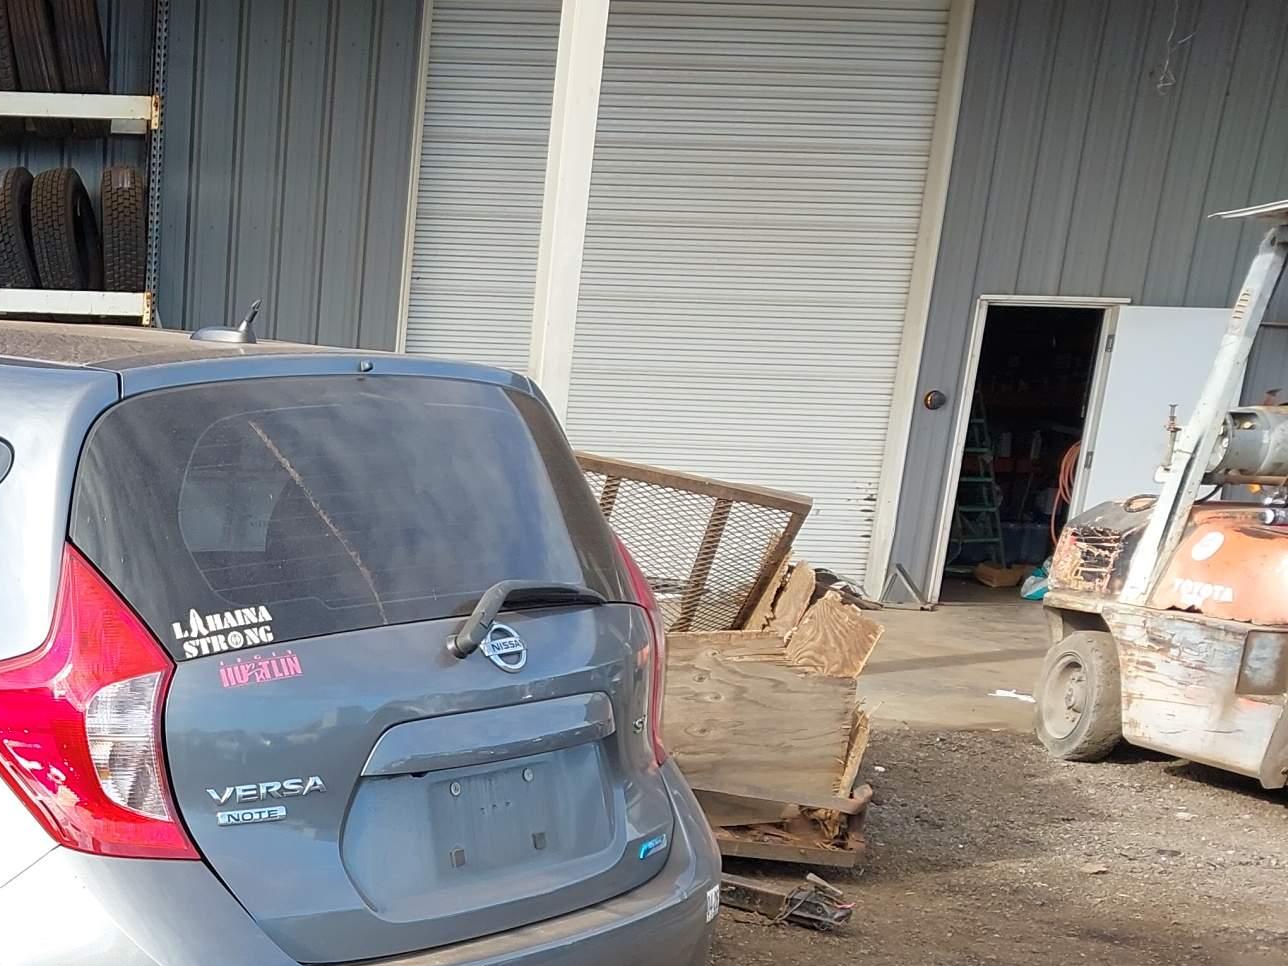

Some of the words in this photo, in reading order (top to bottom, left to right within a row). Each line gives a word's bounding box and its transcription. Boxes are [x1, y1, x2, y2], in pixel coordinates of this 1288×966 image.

[172, 605, 273, 640] LAHAINA
[183, 625, 274, 659] STRONG
[206, 775, 327, 805] VERSA
[227, 809, 279, 823] NOTE
